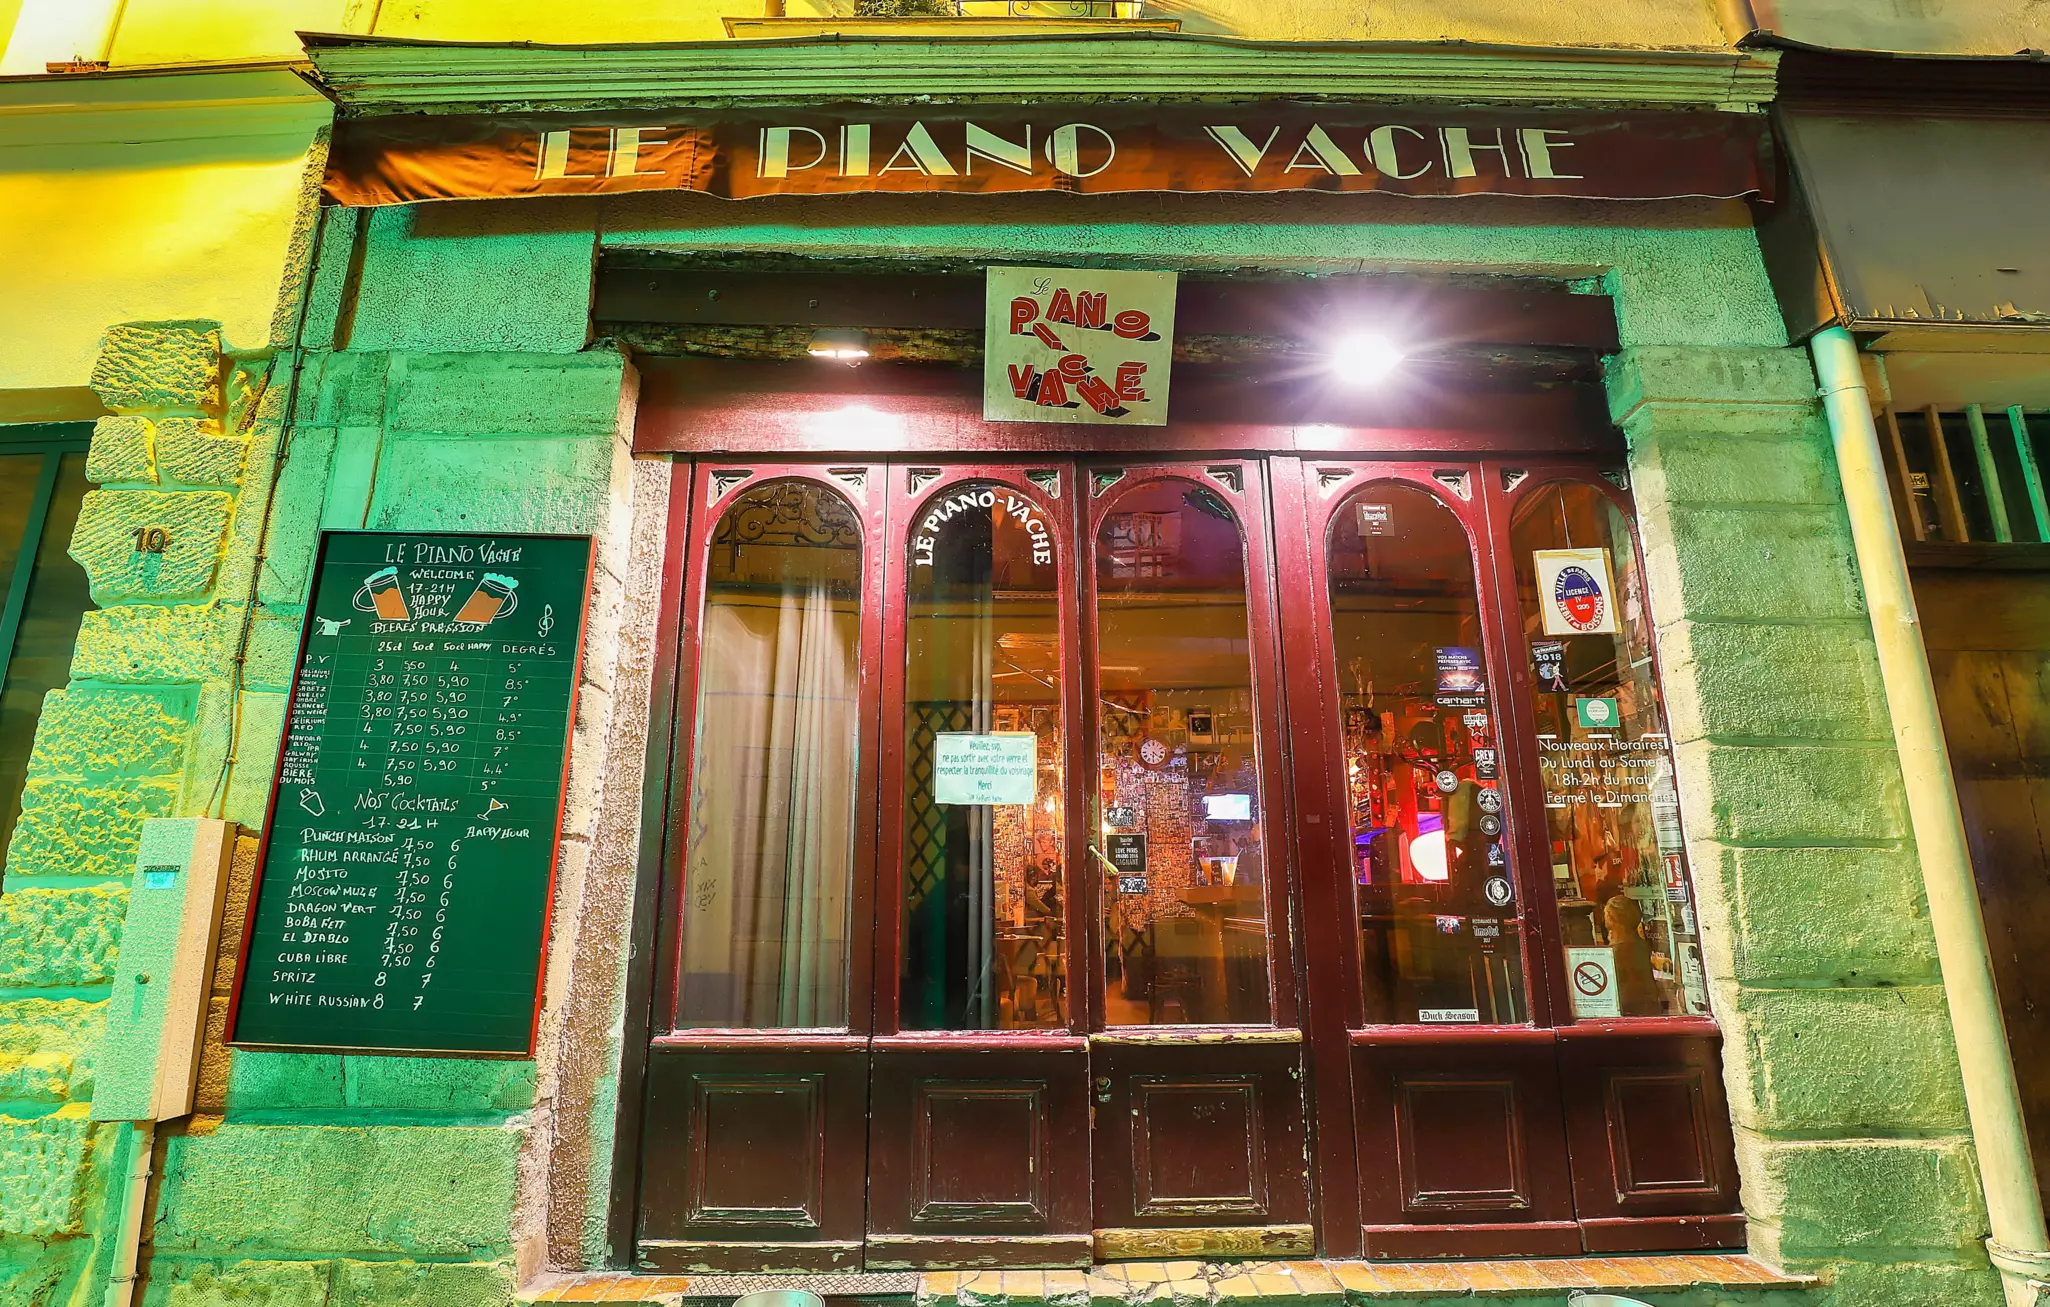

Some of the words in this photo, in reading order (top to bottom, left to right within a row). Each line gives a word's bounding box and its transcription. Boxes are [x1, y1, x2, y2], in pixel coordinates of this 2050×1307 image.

[534, 126, 667, 181] LE
[758, 120, 1116, 178] PIANO
[1203, 123, 1583, 180] VACHE
[1030, 276, 1051, 295] Le
[1010, 287, 1150, 350] PIANO
[1008, 354, 1147, 413] VACHE
[132, 527, 166, 553] 10
[385, 543, 406, 563] LE
[414, 542, 474, 564] PIANO
[915, 536, 936, 566] LE
[409, 569, 474, 580] WELCOME
[1556, 571, 1568, 594] VILLE
[1575, 568, 1592, 582] PARIS
[406, 583, 455, 594] 17-21H
[1565, 587, 1589, 596] LICENCE
[409, 594, 451, 608] HAPPY
[413, 606, 450, 620] HOUR
[1581, 596, 1604, 631] BOISSONS
[421, 622, 486, 634] PRESSION
[467, 642, 492, 651] HAPPY
[503, 642, 556, 656] DEGRÉS
[1535, 653, 1562, 661] 2018
[374, 659, 384, 671] 3
[450, 661, 459, 671] 4
[368, 674, 394, 687] 3,80
[402, 674, 428, 686] 7,50
[437, 675, 469, 689] 5,90
[365, 689, 393, 703] 3,80
[399, 690, 428, 704] 7,50
[435, 691, 467, 704] 5,90
[361, 704, 392, 720] 3,80
[396, 706, 427, 720] 7,50
[432, 706, 469, 721] 5,90
[363, 721, 373, 734] 4
[393, 722, 423, 736] 7,50
[430, 724, 466, 737] 5,90
[360, 739, 369, 750] 4
[389, 741, 419, 753] 7,50
[425, 742, 460, 754] 5,90
[1538, 739, 1605, 751] Nouveaux
[1609, 738, 1664, 751] Horaires
[1475, 749, 1495, 761] CREW
[1539, 756, 1557, 769] Du
[1561, 754, 1595, 769] Lundi
[1599, 759, 1615, 768] au
[357, 757, 367, 769] 4
[386, 758, 416, 771] 7,50
[423, 759, 457, 772] 5,90
[384, 773, 413, 787] 5,90
[977, 780, 992, 790] Merci
[1554, 773, 1599, 786] 18h-2h
[1603, 774, 1620, 785] du
[354, 788, 389, 811] NOS
[391, 792, 459, 812] COCKTAILS
[1546, 791, 1586, 804] Fermé
[1590, 791, 1602, 804] le
[300, 827, 345, 844] PUNCH
[346, 831, 396, 844] MAISON
[401, 838, 434, 852] 7,50
[450, 839, 461, 852] 6
[464, 826, 500, 840] HAPPY
[500, 828, 530, 839] HOUR
[301, 848, 338, 862] RHUM
[343, 848, 399, 863] ARRANGÉ
[403, 853, 430, 868] 7,50
[448, 854, 457, 870] 6
[294, 866, 348, 882] MOJITO
[395, 870, 430, 887] 7,50
[443, 873, 453, 889] 6
[288, 884, 341, 898] MOSCOW
[394, 887, 426, 904] 7,50
[440, 891, 450, 907] 6
[284, 902, 337, 914] DRAGON
[340, 902, 376, 914] VERT
[389, 905, 422, 920] 7,50
[435, 908, 446, 922] 6
[284, 916, 318, 929] BOBA
[320, 917, 347, 930] FETT
[386, 922, 418, 937] 7,50
[432, 925, 444, 940] 6
[282, 932, 297, 942] EL
[301, 931, 349, 944] DIABLO
[383, 937, 414, 954] 7,50
[429, 940, 440, 953] 6
[277, 952, 311, 963] CUBA
[315, 949, 348, 964] LIBRE
[381, 954, 411, 968] 7,50
[425, 955, 436, 968] 6
[272, 968, 316, 984] SPRITZ
[374, 971, 387, 987] 8
[421, 973, 432, 989] 7
[269, 990, 312, 1006] WHITE
[318, 994, 370, 1009] RUSSIAN
[372, 993, 385, 1010] 8
[412, 995, 424, 1011] 7
